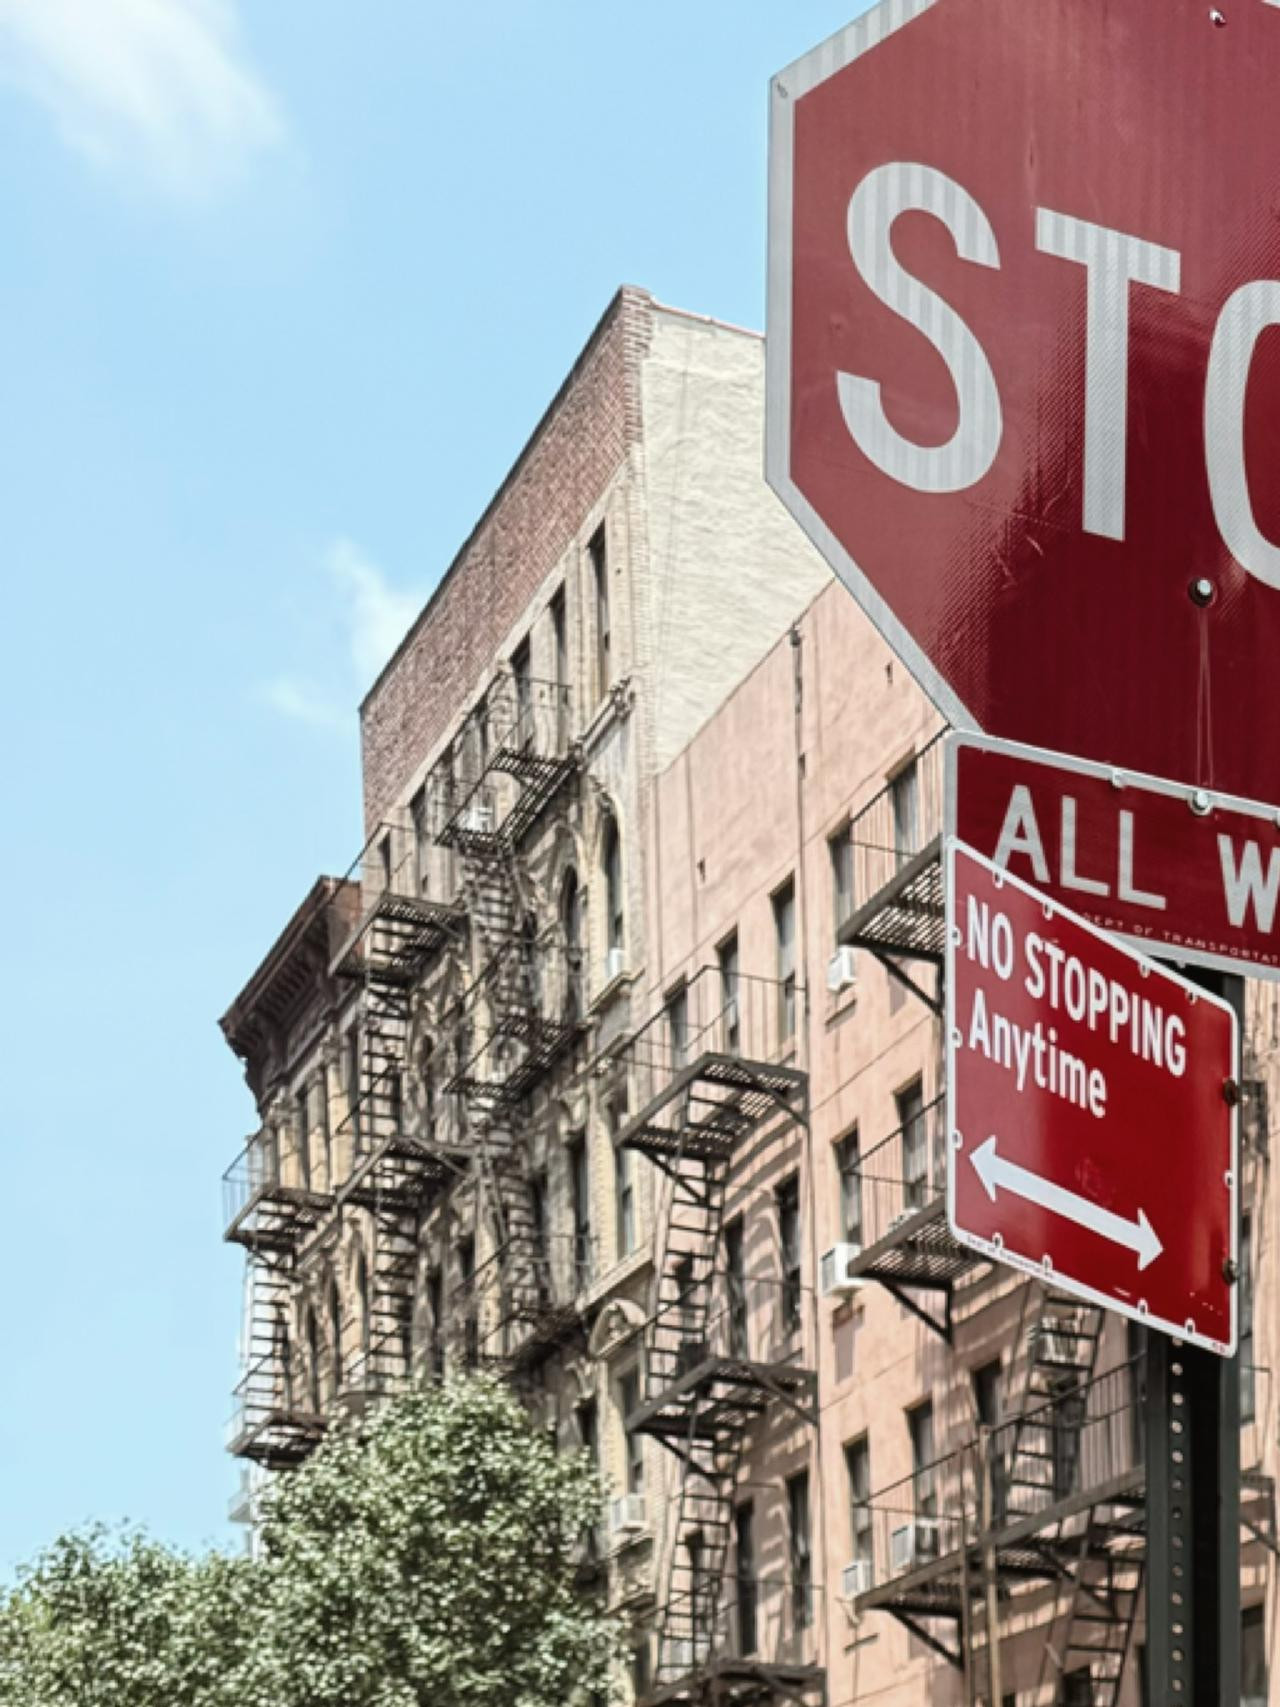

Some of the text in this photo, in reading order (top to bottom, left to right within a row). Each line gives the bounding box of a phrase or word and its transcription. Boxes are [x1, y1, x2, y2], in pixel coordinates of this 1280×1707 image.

[994, 783, 1167, 911] ALL
[967, 892, 1186, 1078] NO STOPPING
[1133, 924, 1153, 936] OF
[968, 1007, 1109, 1119] Anytime
